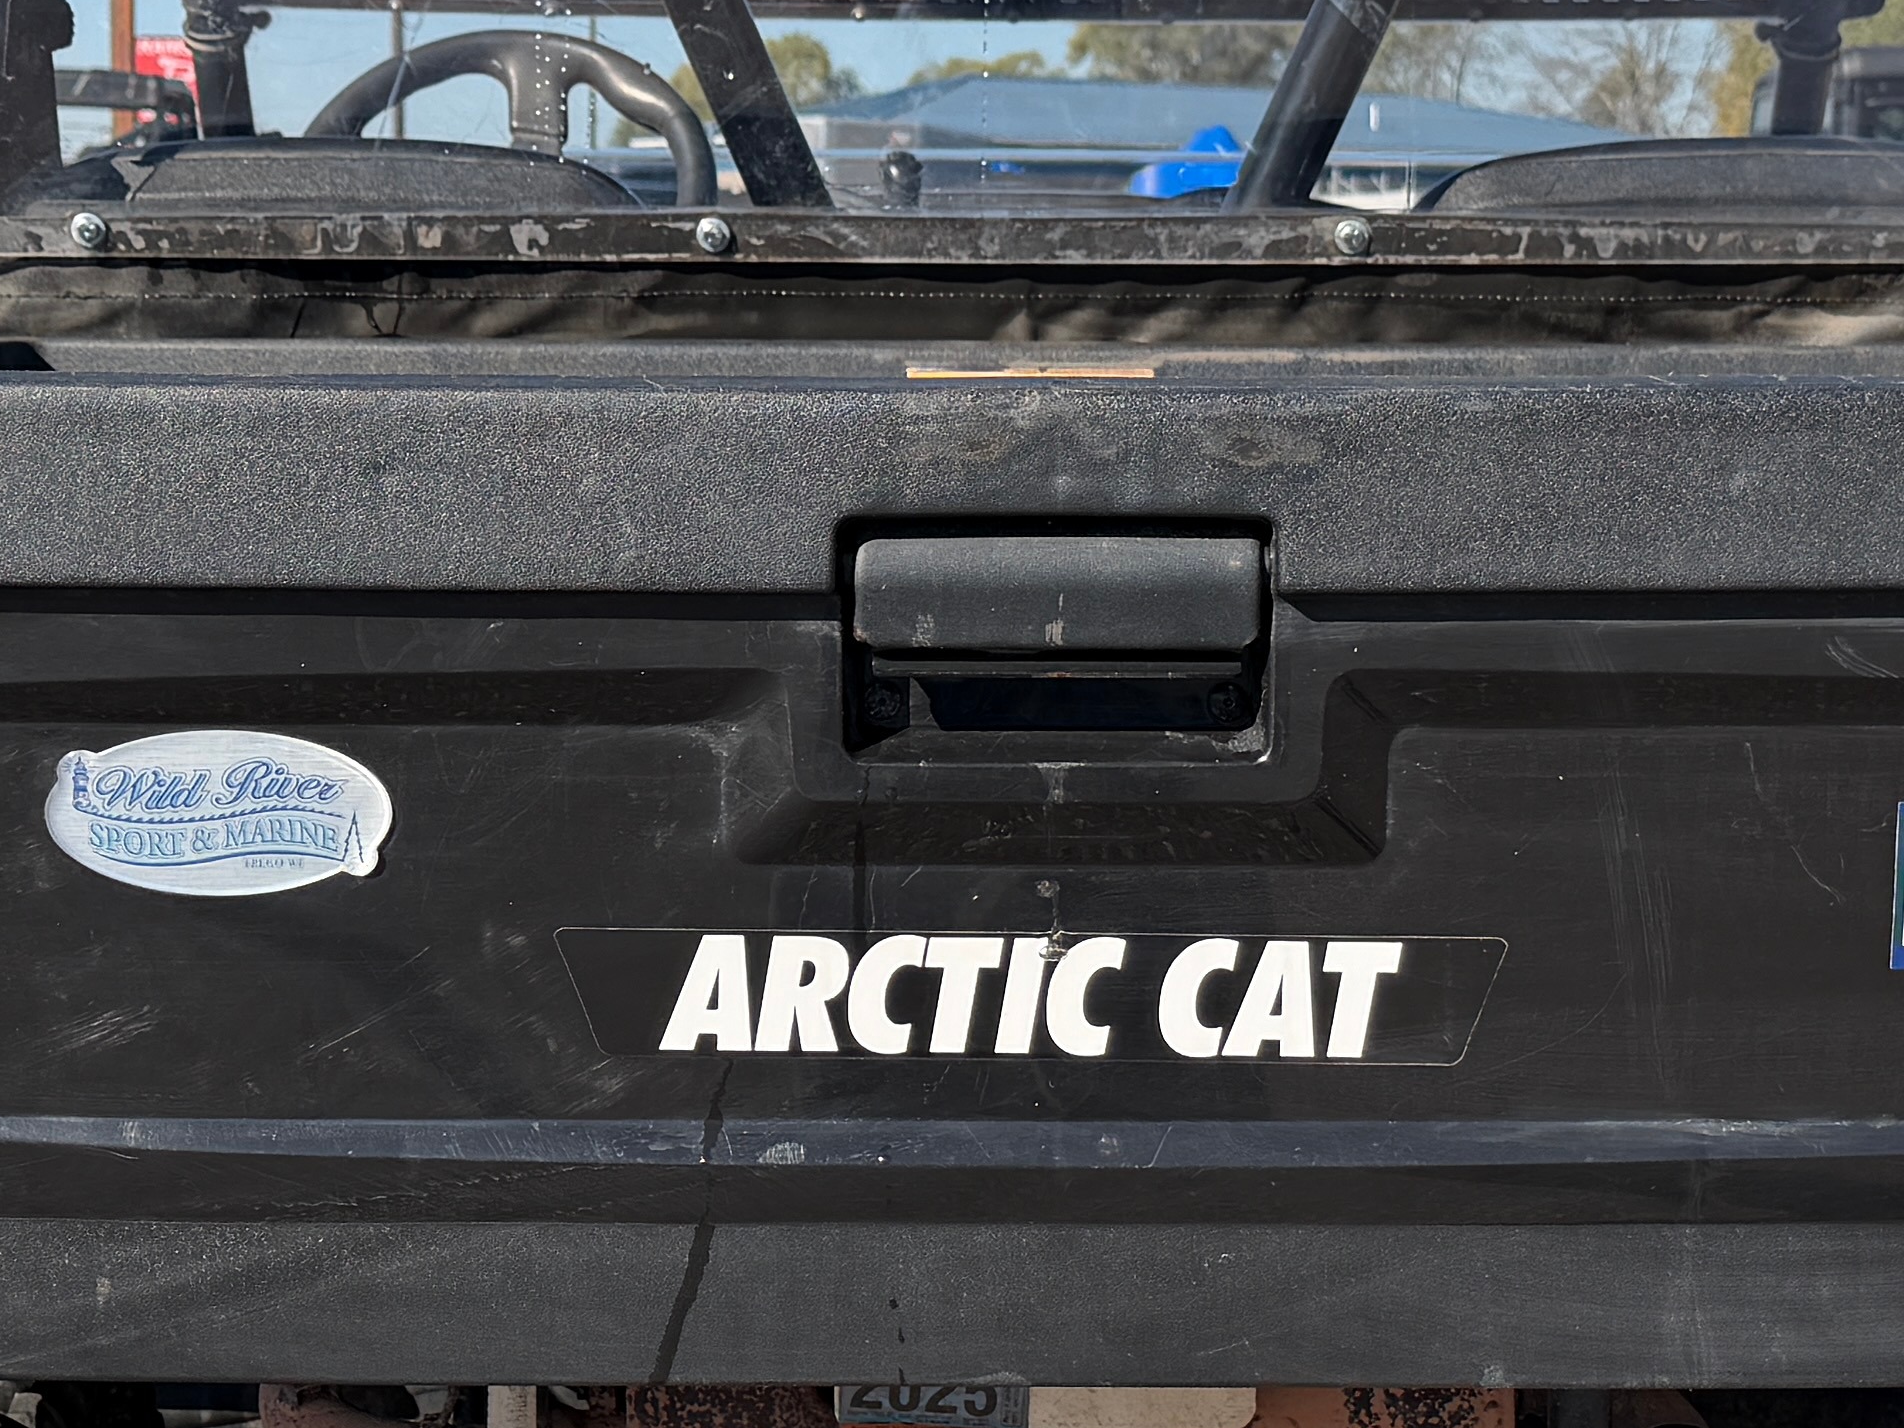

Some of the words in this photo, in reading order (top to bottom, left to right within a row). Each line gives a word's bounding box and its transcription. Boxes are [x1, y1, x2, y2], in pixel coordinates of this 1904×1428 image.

[94, 766, 211, 812] Wild
[212, 756, 346, 806] River
[89, 822, 186, 857] SPORT
[191, 826, 219, 853] &
[223, 817, 339, 853] MARINE
[657, 933, 1127, 1057] ARCTIC
[1157, 937, 1404, 1059] CAT
